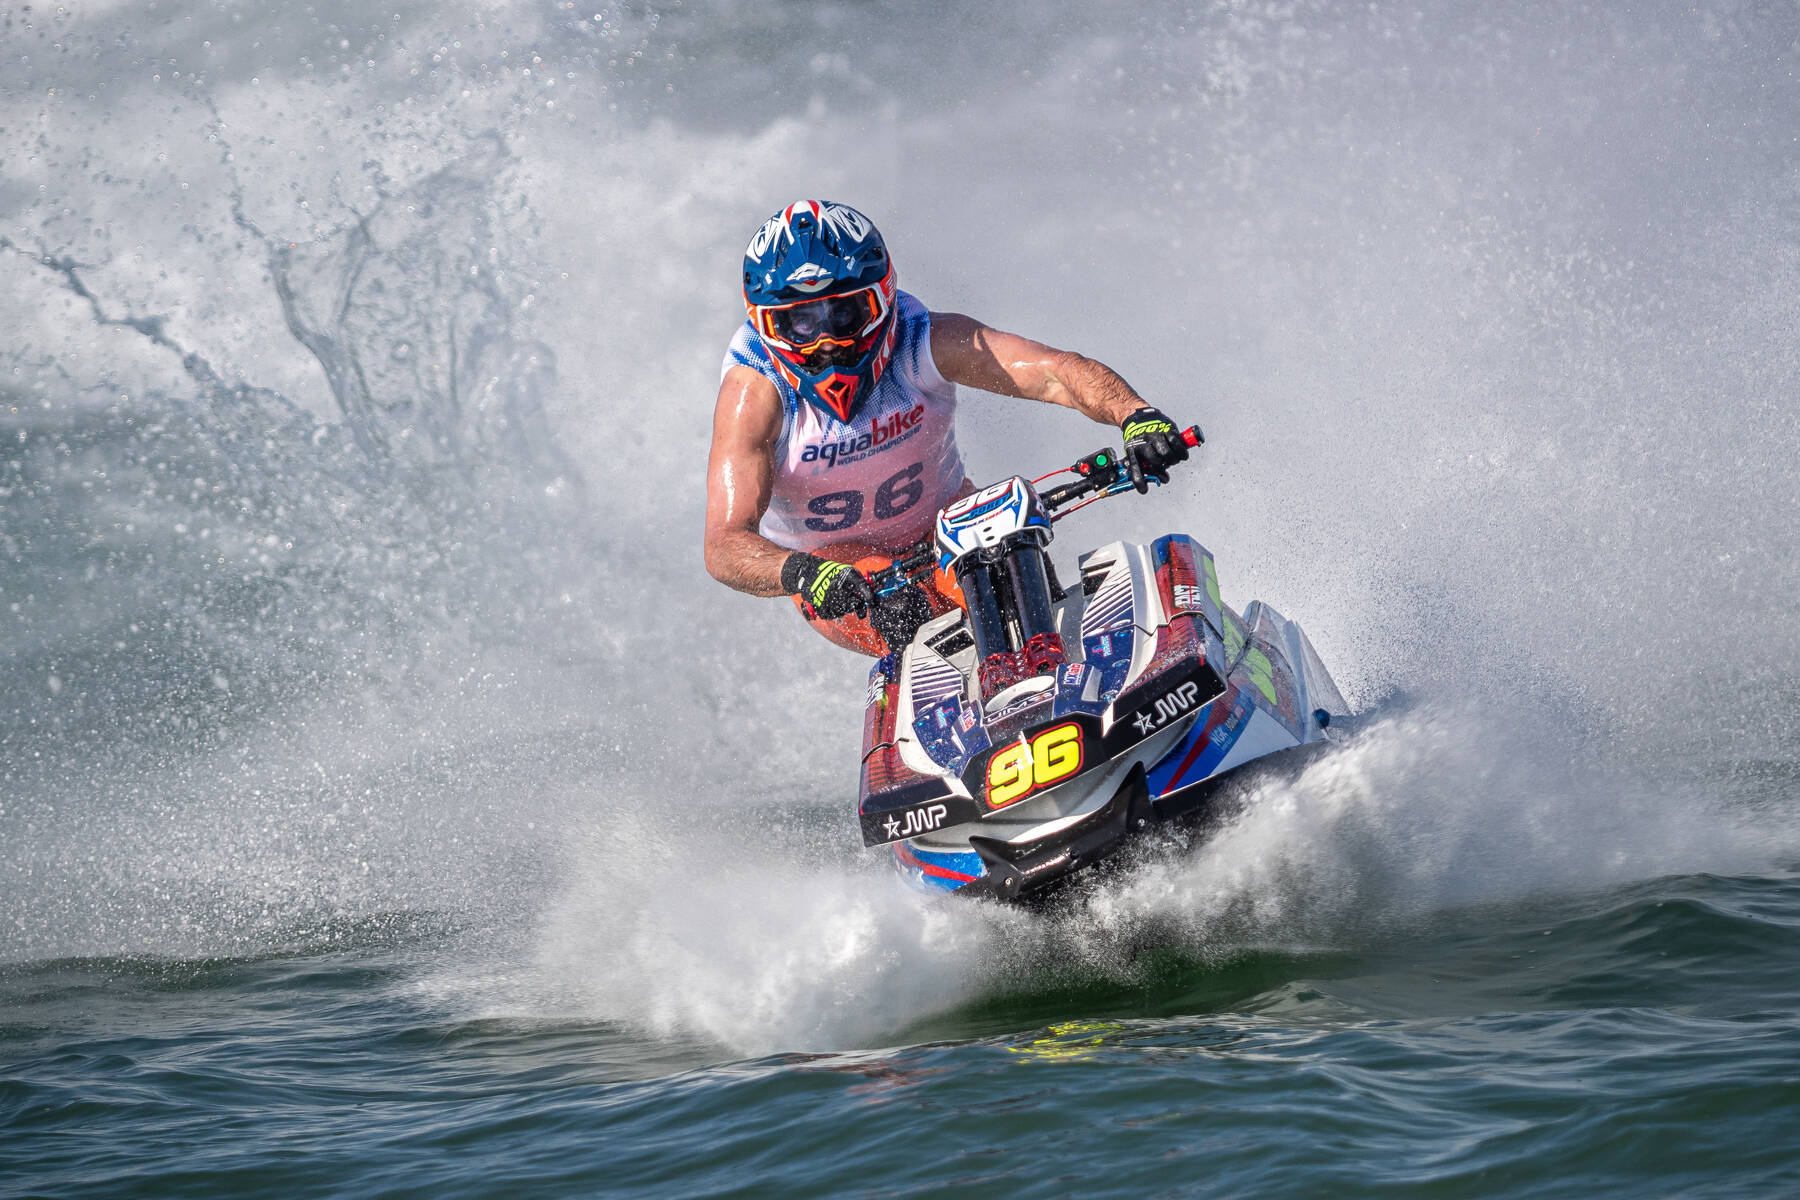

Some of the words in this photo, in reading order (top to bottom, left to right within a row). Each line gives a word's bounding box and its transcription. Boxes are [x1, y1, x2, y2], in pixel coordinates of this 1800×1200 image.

[801, 404, 924, 468] aquabike
[837, 452, 866, 466] WORLD
[868, 424, 922, 457] CHAMPIONSHIP
[1130, 422, 1171, 439] 100%
[804, 462, 924, 532] 96
[813, 568, 840, 607] 100%
[1154, 681, 1198, 725] JWP
[985, 722, 1083, 809] 96
[901, 804, 947, 835] JWP
